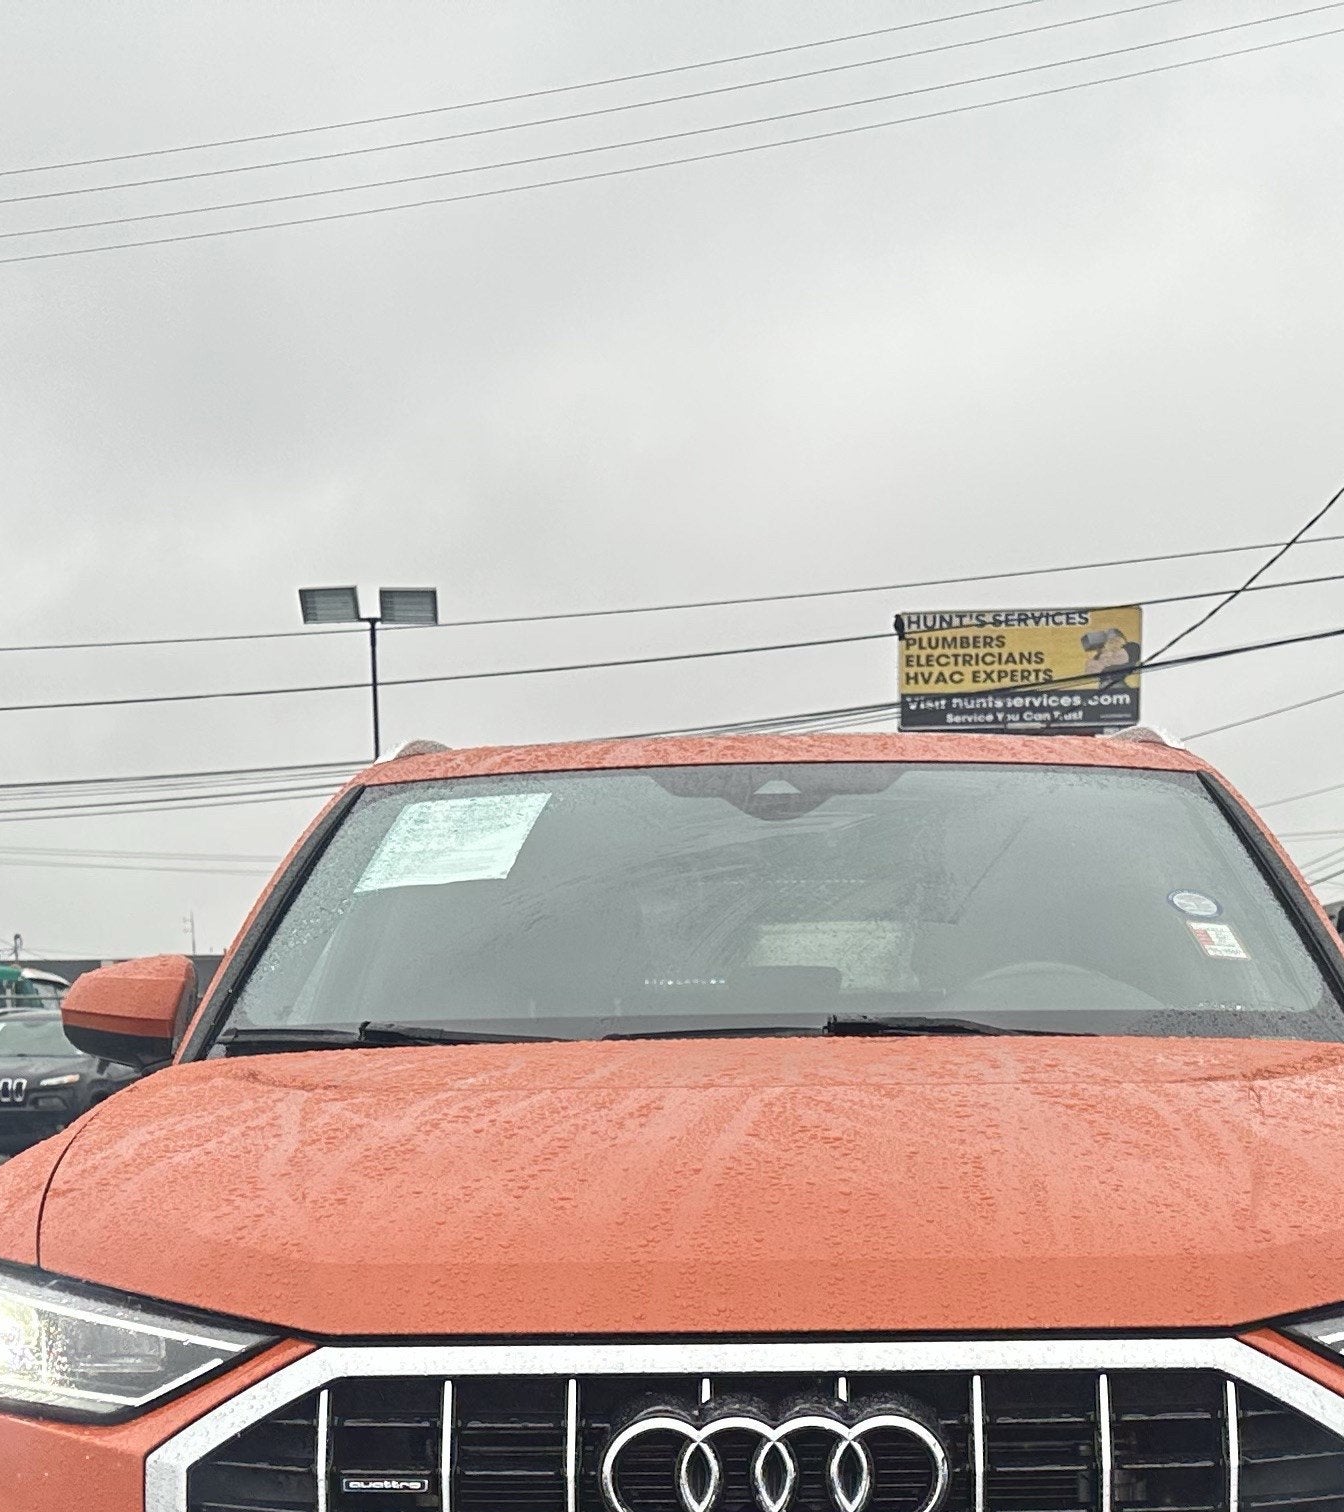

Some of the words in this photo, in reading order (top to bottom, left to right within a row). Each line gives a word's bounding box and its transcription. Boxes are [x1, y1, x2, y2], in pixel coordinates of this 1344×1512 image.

[907, 613, 987, 630] HUNT'S
[991, 610, 1089, 628] SERVICES
[906, 635, 1006, 650] PLUMBERS
[905, 651, 1045, 668] ELECTRICIANS
[905, 670, 965, 685] HVAC
[971, 668, 1054, 684] EXPERTS
[945, 712, 995, 724] Service
[1022, 711, 1052, 722] Can
[348, 1480, 422, 1490] quattro
